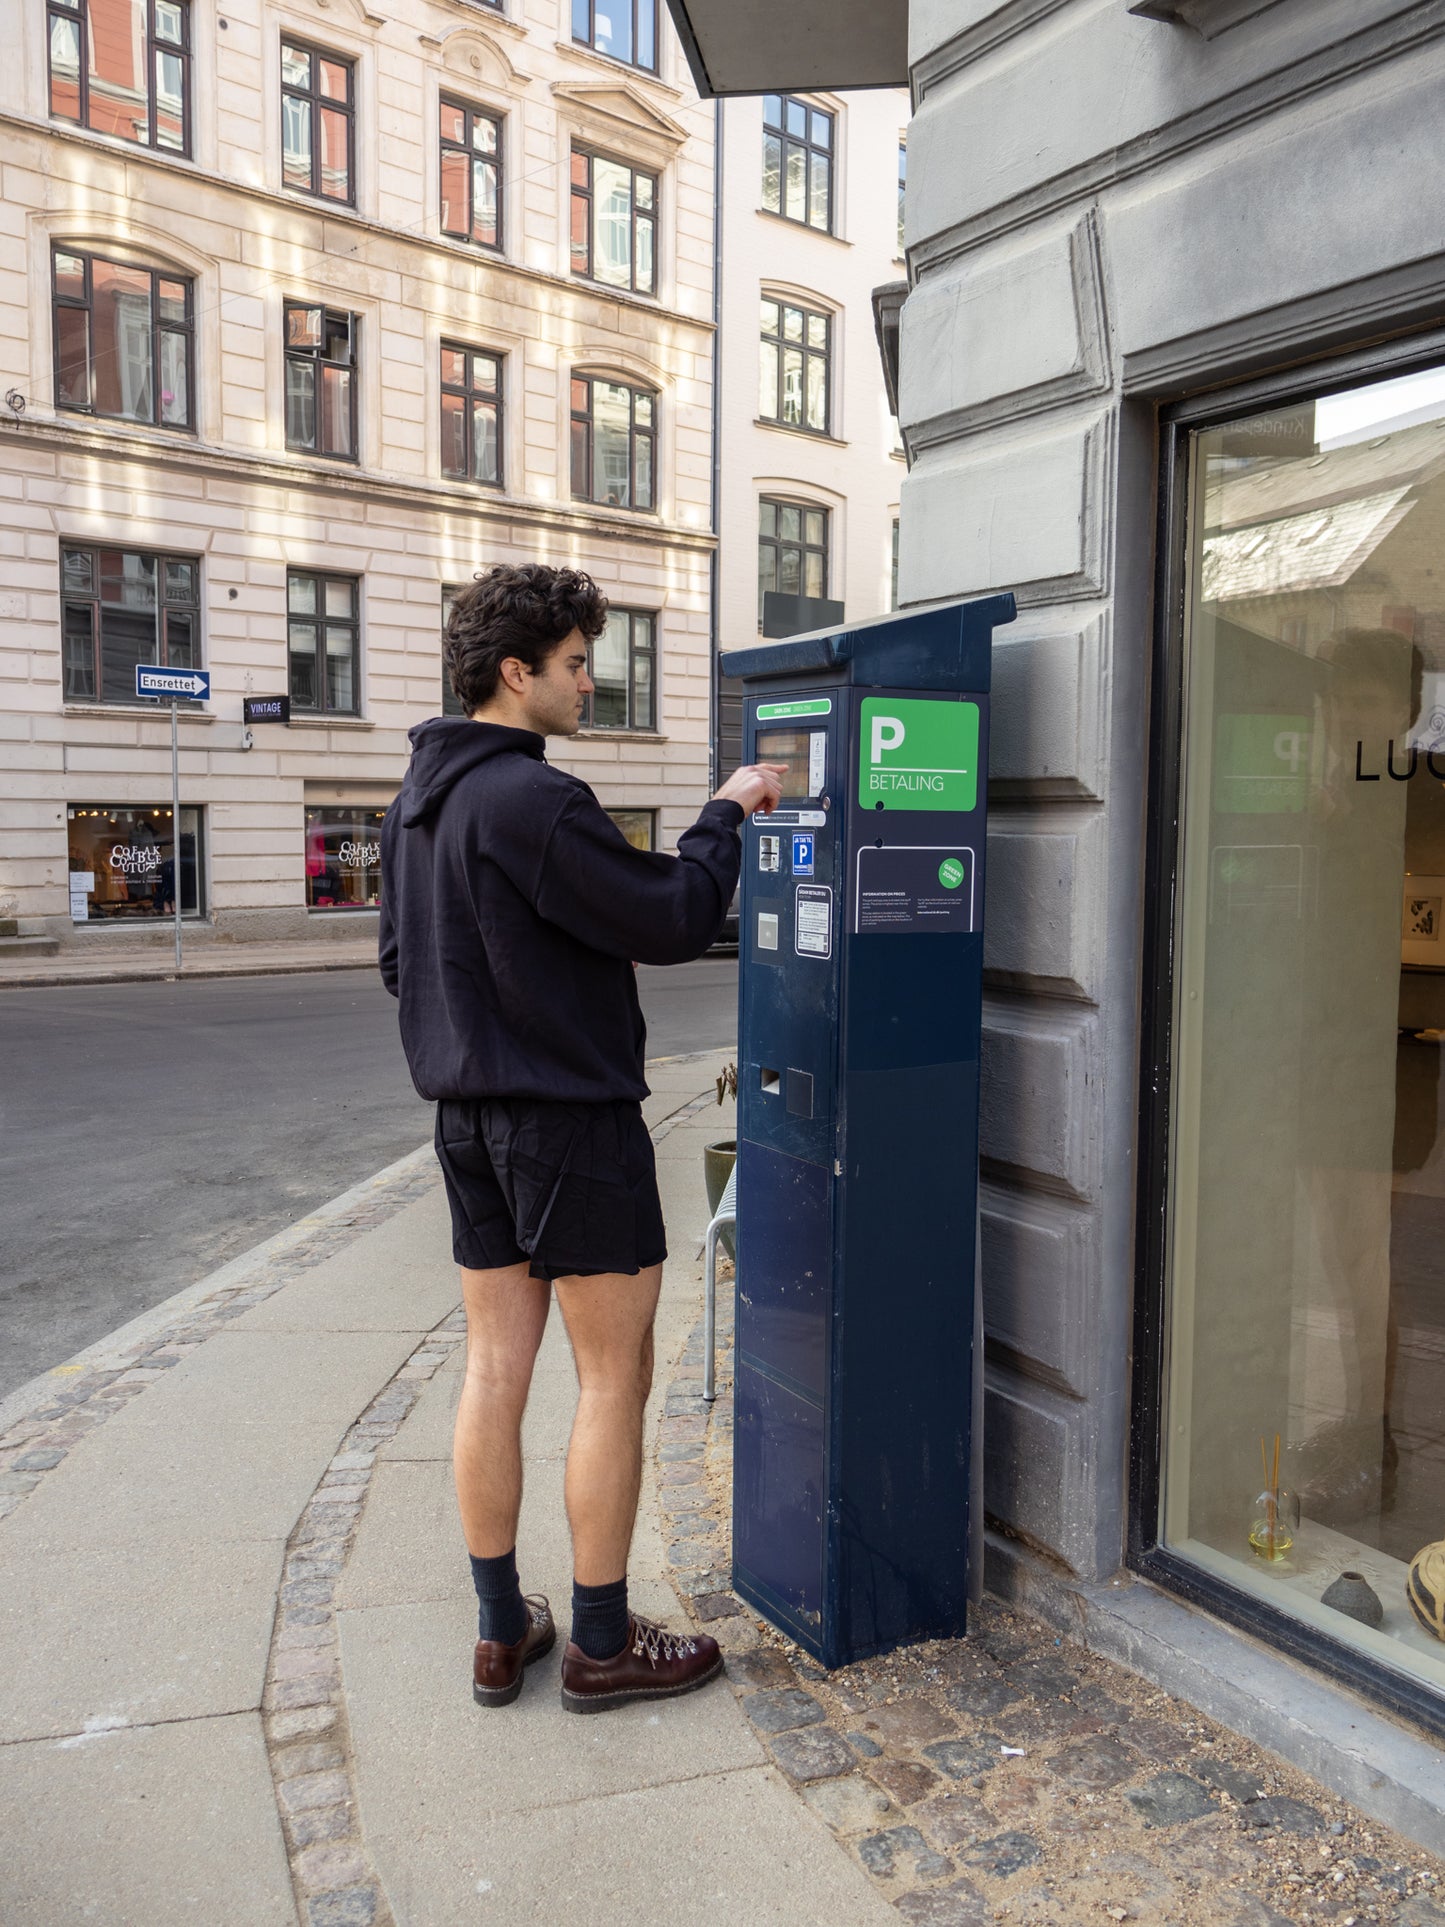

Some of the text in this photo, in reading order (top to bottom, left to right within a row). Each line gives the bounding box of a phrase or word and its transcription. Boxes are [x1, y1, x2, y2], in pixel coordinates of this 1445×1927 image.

[143, 675, 196, 691] Ensrettet
[250, 701, 282, 713] VINTAGE
[871, 716, 906, 764] P
[870, 774, 944, 791] BETALING
[799, 844, 808, 864] P
[942, 870, 957, 883] ZONE
[943, 863, 962, 878] GREEN
